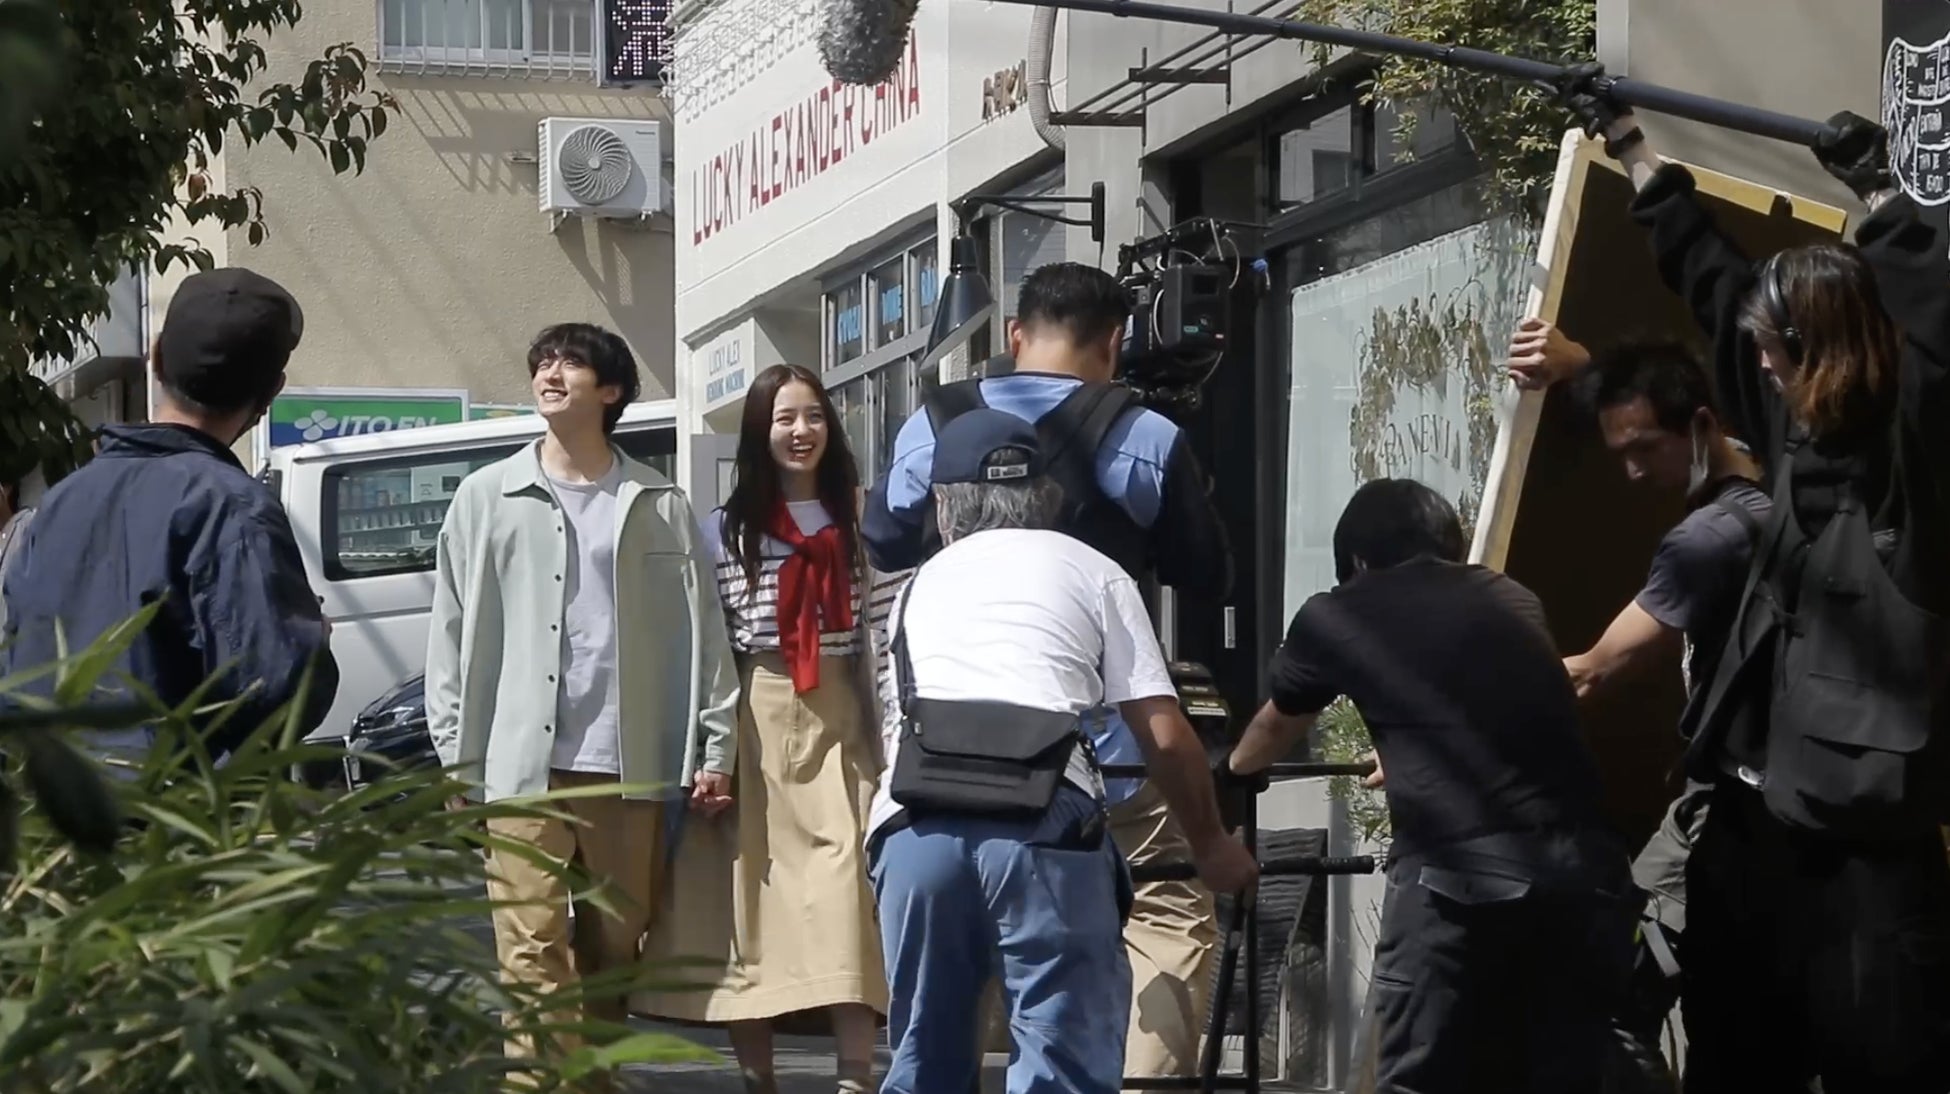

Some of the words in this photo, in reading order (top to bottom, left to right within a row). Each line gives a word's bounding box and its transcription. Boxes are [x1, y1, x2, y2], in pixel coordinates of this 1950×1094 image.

[693, 140, 745, 247] LUCKY
[749, 80, 855, 214] ALEXANDER
[337, 415, 393, 435] ITO
